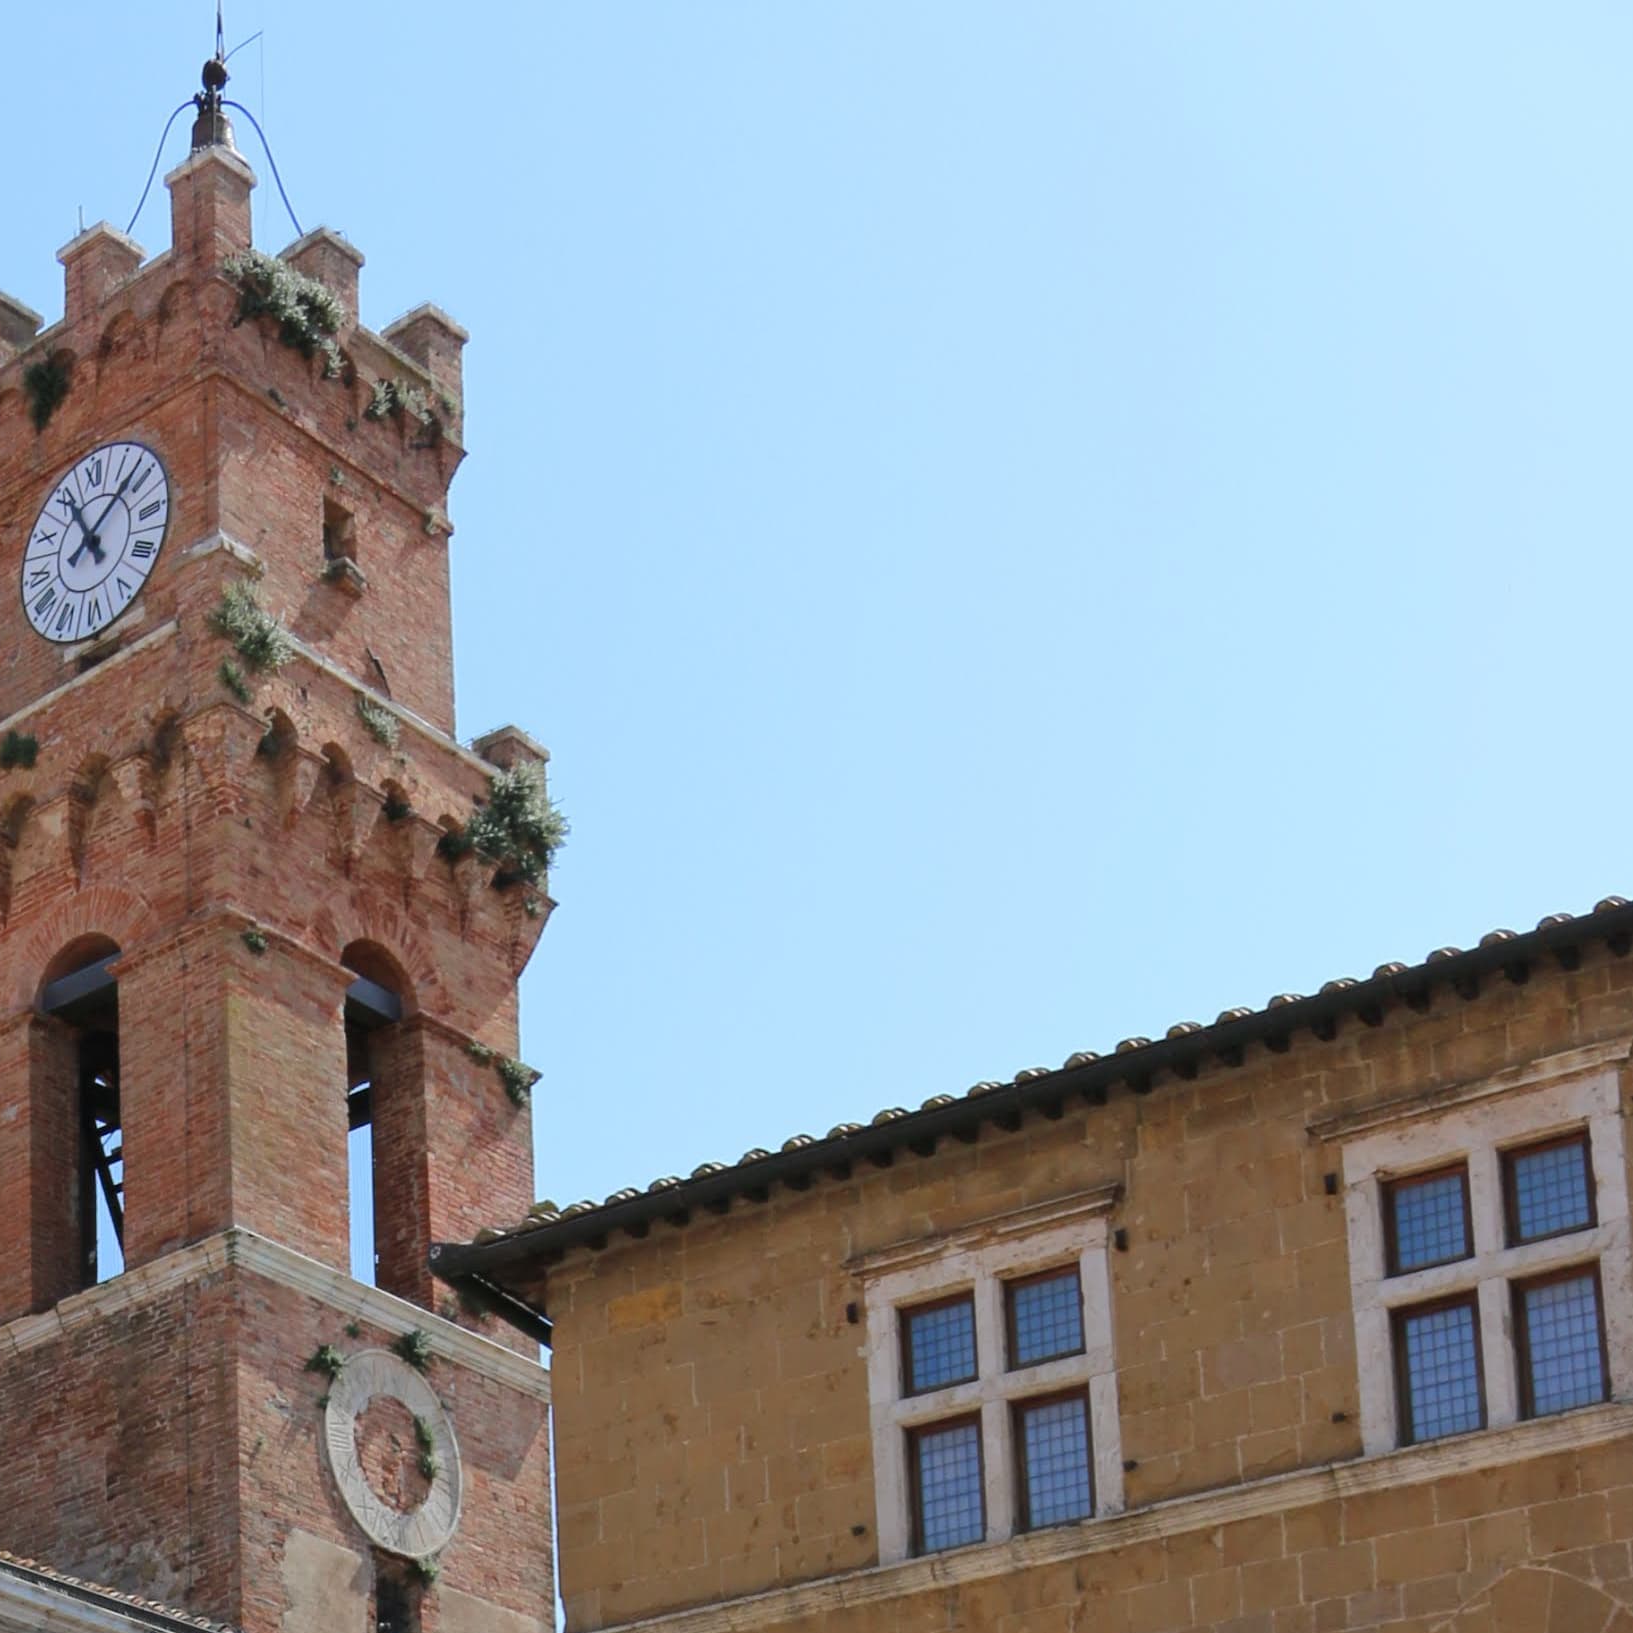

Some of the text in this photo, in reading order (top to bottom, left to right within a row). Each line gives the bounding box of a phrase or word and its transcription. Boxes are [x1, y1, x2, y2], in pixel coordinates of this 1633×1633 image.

[85, 459, 103, 494] XII
[138, 500, 161, 522] III
[36, 529, 58, 546] X
[132, 541, 154, 558] IIII
[29, 561, 51, 589] IX
[117, 577, 132, 600] V
[33, 587, 58, 624] VIII
[55, 602, 76, 633] VII
[87, 598, 103, 627] VI
